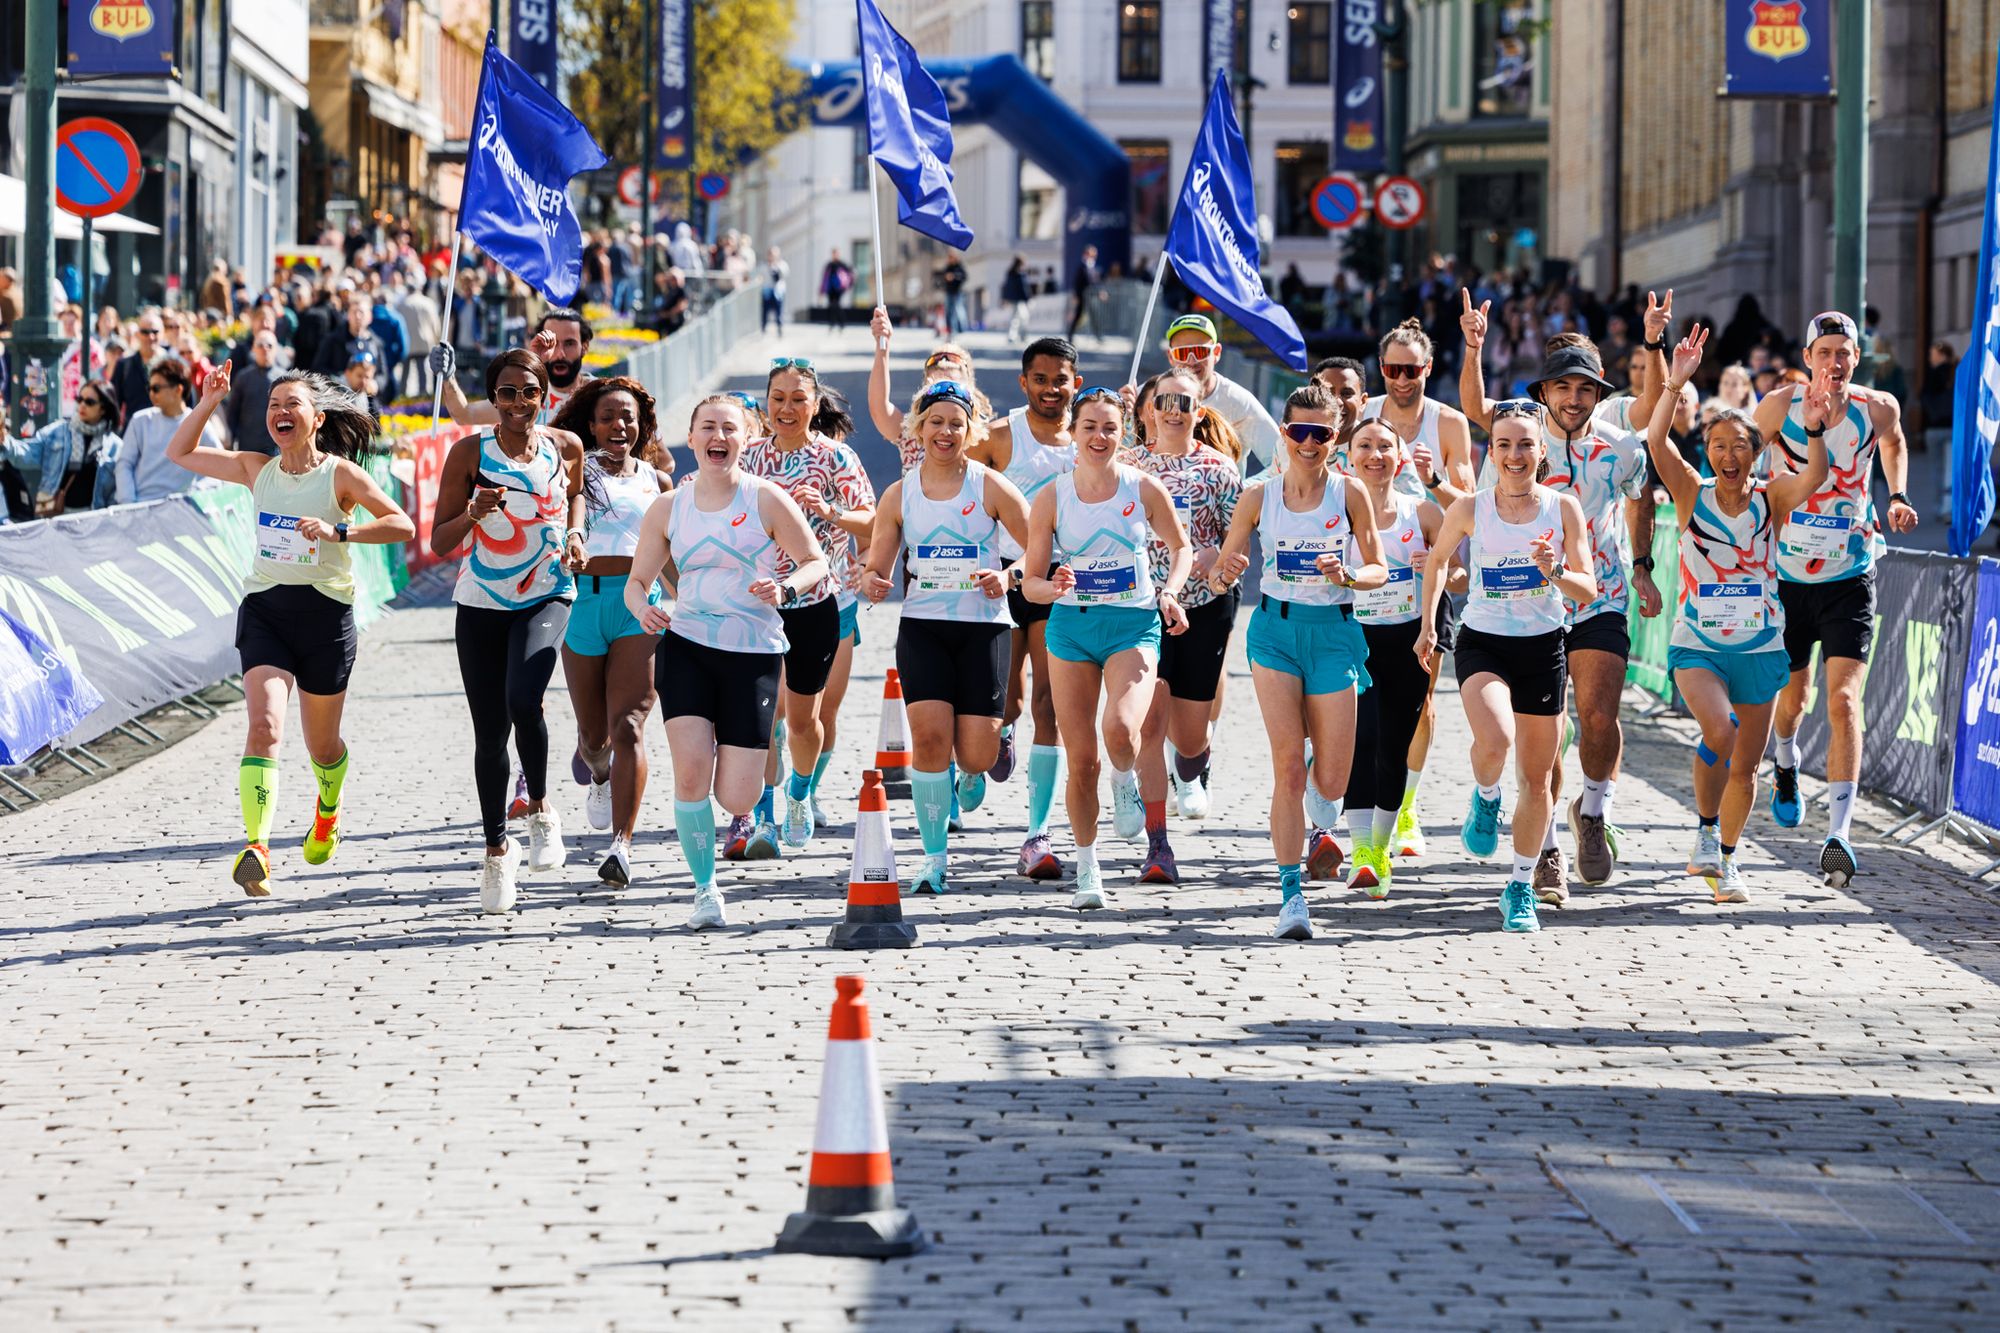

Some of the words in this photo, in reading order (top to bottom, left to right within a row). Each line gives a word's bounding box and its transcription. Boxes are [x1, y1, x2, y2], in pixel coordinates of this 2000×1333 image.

[280, 518, 298, 528] asic
[1814, 518, 1837, 527] asics
[281, 536, 291, 544] Thu
[940, 547, 964, 557] asics
[298, 554, 312, 564] XXL
[1507, 557, 1529, 565] asics
[1098, 560, 1119, 569] asics
[1093, 577, 1116, 585] Viktoria
[1501, 574, 1529, 582] Dominika
[959, 582, 973, 590] XXL
[1724, 586, 1748, 595] asics
[1744, 619, 1758, 628] XXL
